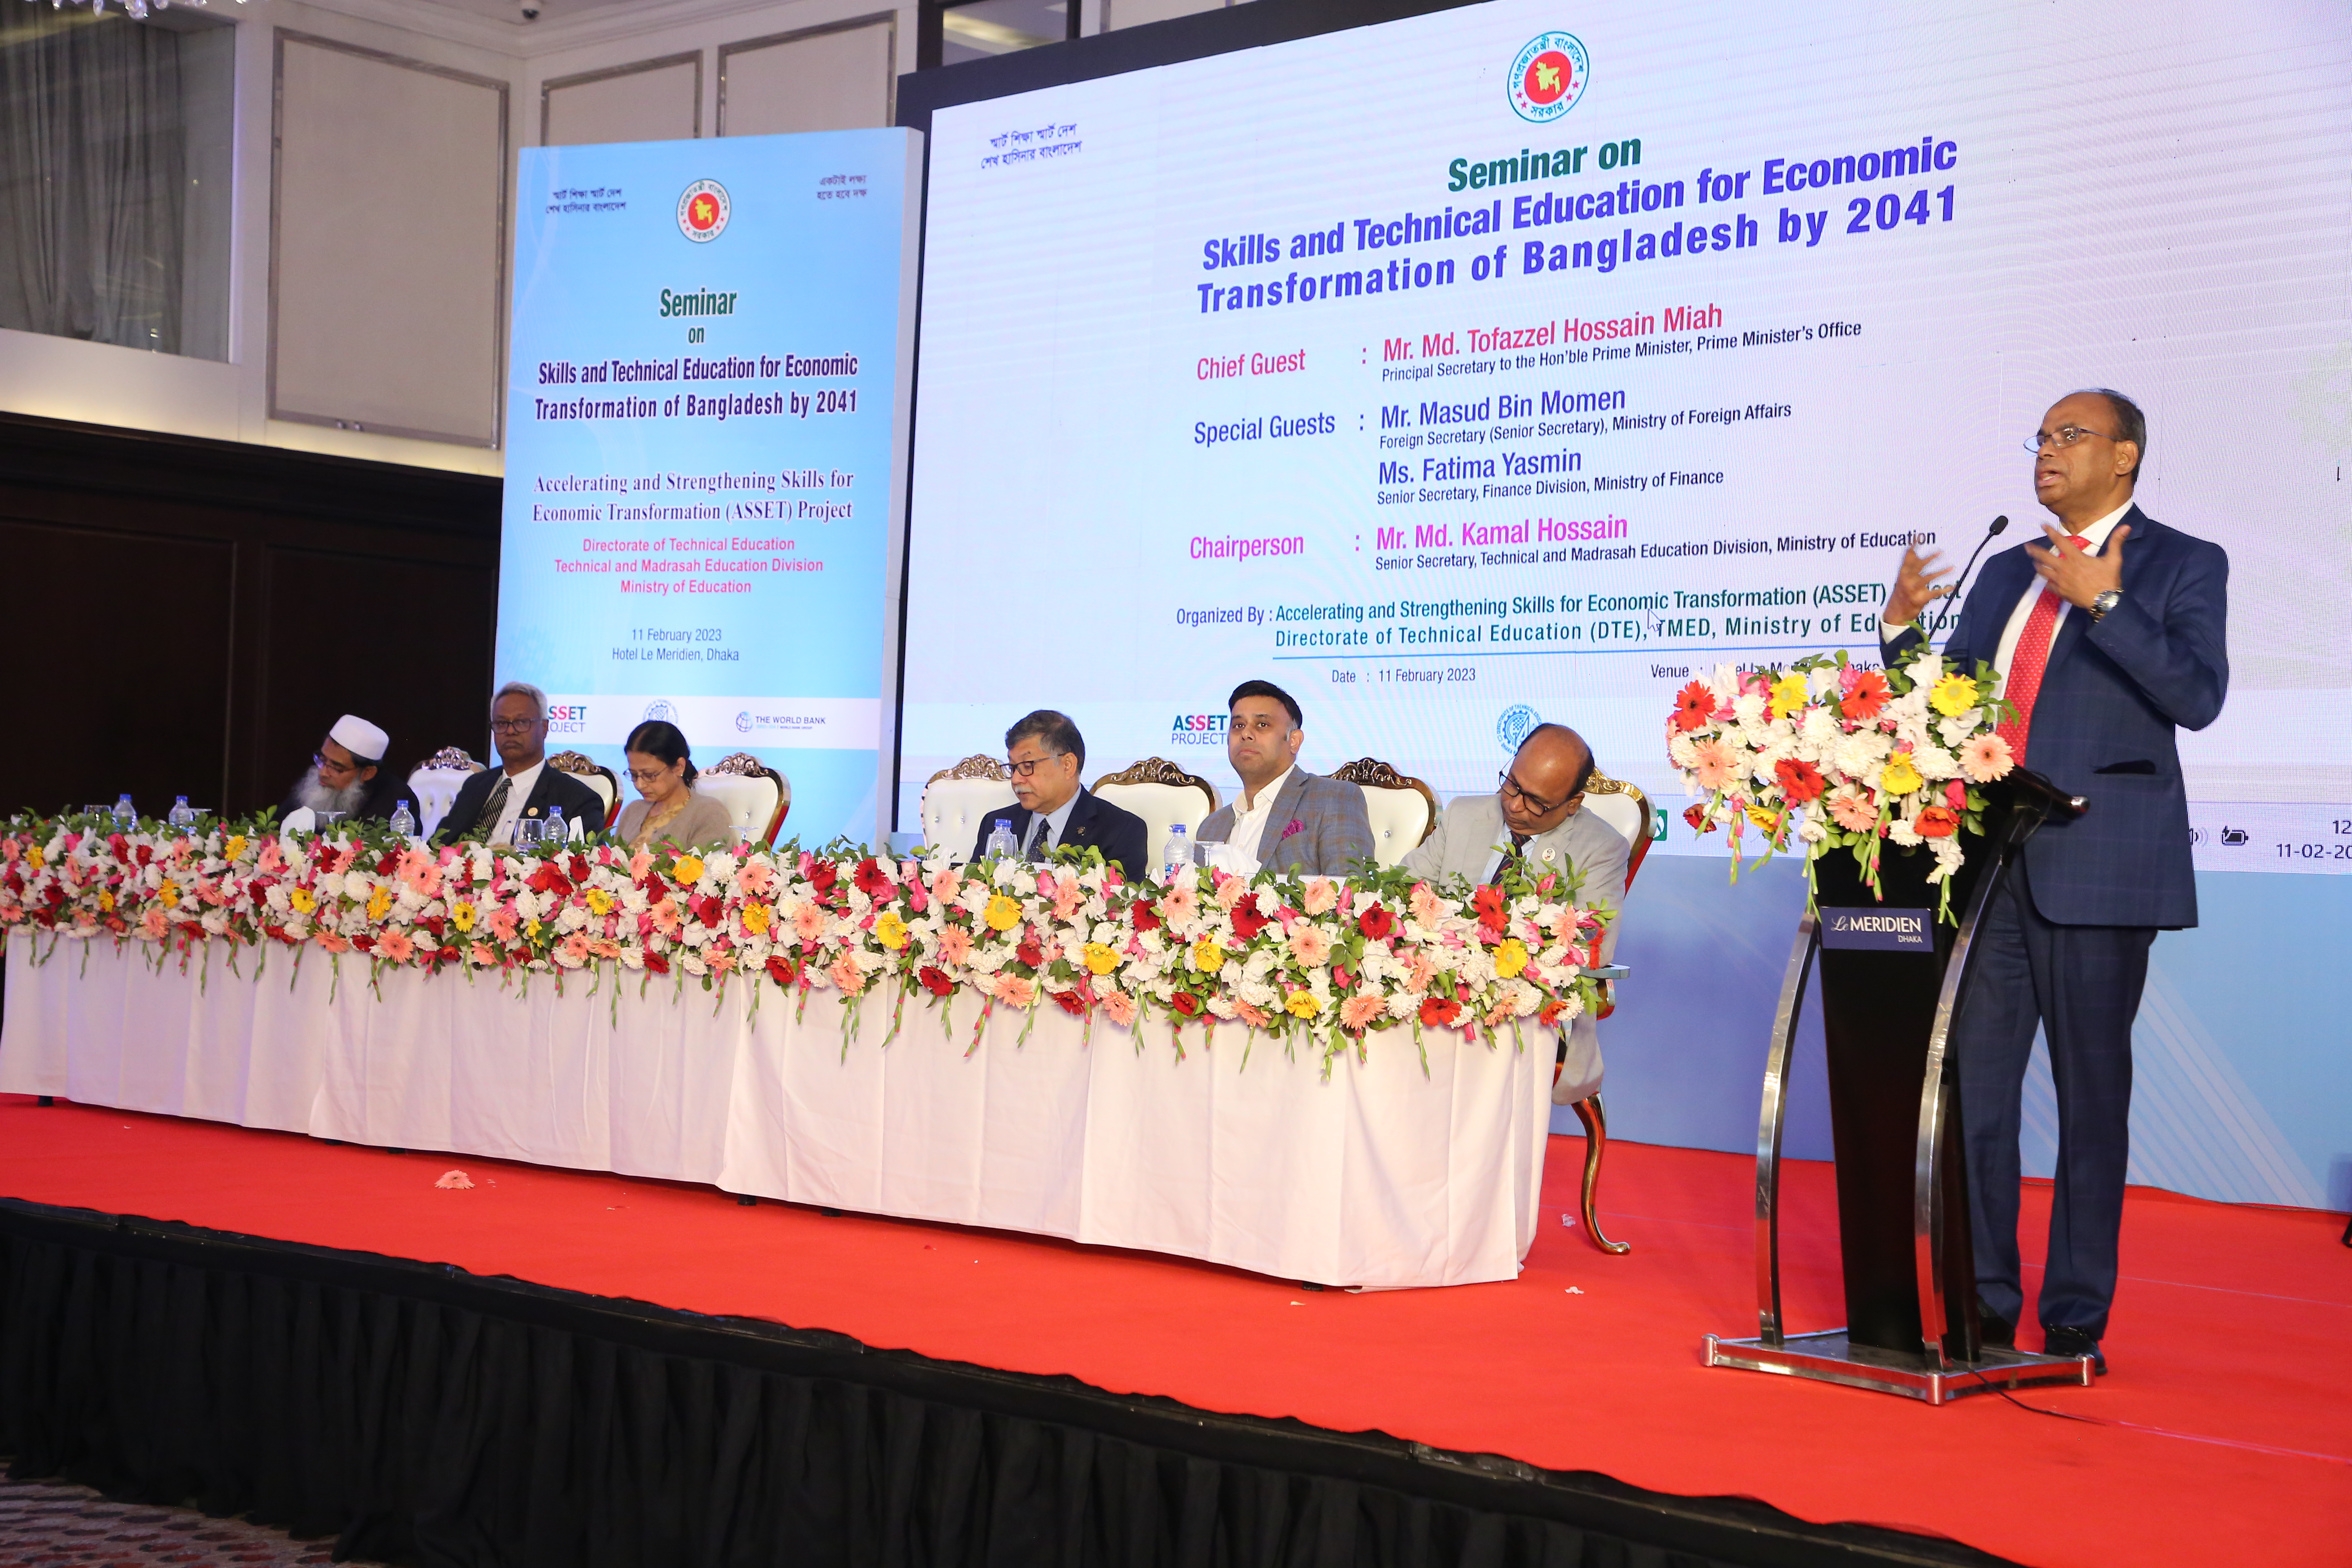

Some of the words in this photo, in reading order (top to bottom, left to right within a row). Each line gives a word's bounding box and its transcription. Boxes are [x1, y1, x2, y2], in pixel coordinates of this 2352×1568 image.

[1448, 146, 1588, 192] Seminar
[1599, 138, 1641, 169] on
[1203, 234, 1280, 270] Skills
[1290, 222, 1344, 259] and
[1354, 200, 1501, 250] Technical
[1513, 180, 1684, 229] Education
[1697, 168, 1751, 203] for
[1763, 136, 1957, 194] Economic
[1198, 257, 1454, 313] Transformation
[1472, 245, 1507, 281] of
[1523, 214, 1757, 274] Bangladesh
[1779, 207, 1828, 247] by
[1847, 185, 1954, 234] 2041
[660, 288, 737, 317] Seminar
[688, 327, 704, 343] on
[1198, 354, 1245, 380] Chief
[1252, 349, 1305, 375] Guest
[1384, 338, 1413, 361] Mr.
[1423, 332, 1459, 358] Md.
[1468, 321, 1555, 353] Tofazzel
[1564, 312, 1654, 344] Hossain
[1664, 303, 1722, 332] Miah
[1383, 364, 1433, 381] Principal
[1437, 361, 1495, 376] Secretary
[1500, 358, 1511, 370] to
[1516, 355, 1535, 369] the
[1593, 346, 1630, 361] Prime
[1635, 340, 1692, 357] Minister,
[1697, 335, 1737, 350] Prime
[1818, 322, 1861, 339] Office
[539, 362, 576, 384] Skills
[581, 361, 607, 383] and
[612, 359, 678, 382] Technical
[684, 357, 754, 379] Education
[760, 355, 780, 377] for
[786, 353, 857, 376] Economic
[536, 396, 656, 419] Transformation
[664, 395, 679, 416] of
[687, 392, 782, 421] Bangladesh
[791, 392, 809, 418] by
[817, 390, 855, 412] 2041
[1195, 418, 1262, 448] Special
[1270, 412, 1335, 438] Guests
[1382, 405, 1410, 428] Mr.
[1420, 397, 1489, 425] Masud
[1499, 394, 1532, 419] Bin
[1541, 390, 1625, 415] Momen
[1380, 434, 1423, 450] Foreign
[1428, 430, 1486, 445] Secretary
[1490, 425, 1534, 443] (Senior
[1538, 418, 1607, 436] Secretary),
[1613, 414, 1666, 430] Ministry
[1671, 411, 1684, 425] of
[1689, 408, 1740, 425] Foreign
[1744, 403, 1791, 419] Affairs
[1380, 461, 1414, 484] Ms.
[1423, 456, 1495, 481] Fatima
[1502, 448, 1581, 476] Yasmin
[533, 474, 628, 494] Accelerating
[634, 474, 660, 490] and
[667, 472, 775, 492] Strengthening
[782, 471, 824, 488] Skills
[831, 470, 853, 487] for
[1378, 490, 1414, 505] Senior
[1419, 487, 1479, 502] Secretary,
[1483, 484, 1531, 498] Finance
[1537, 479, 1589, 494] Division,
[1595, 475, 1648, 491] Ministry
[1652, 472, 1665, 487] of
[1670, 472, 1724, 486] Finance
[534, 504, 601, 521] Economic
[606, 503, 720, 521] Transformation
[726, 501, 792, 520] (ASSET)
[799, 501, 851, 522] Project
[583, 539, 649, 552] Directorate
[654, 538, 666, 551] of
[669, 538, 727, 551] Technical
[732, 537, 795, 550] Education
[1191, 535, 1303, 562] Chairperson
[1377, 527, 1406, 550] Mr.
[1416, 524, 1452, 548] Md.
[1463, 519, 1529, 546] Kamal
[1538, 514, 1627, 541] Hossain
[1376, 556, 1413, 570] Senior
[1417, 554, 1477, 569] Secretary,
[1481, 550, 1538, 565] Technical
[1543, 548, 1566, 562] and
[1572, 545, 1635, 561] Madrasah
[1641, 543, 1708, 558] Education
[1713, 539, 1772, 555] Division,
[1777, 536, 1836, 552] Ministry
[1841, 533, 1855, 548] of
[1860, 529, 1936, 548] Education
[555, 559, 611, 572] Technical
[615, 559, 637, 572] and
[641, 559, 700, 572] Madrasah
[705, 559, 767, 572] Education
[772, 558, 823, 571] Division
[621, 580, 669, 596] Ministry
[673, 580, 686, 592] of
[689, 580, 751, 592] Education
[1177, 607, 1243, 627] Organized
[1248, 607, 1264, 626] By
[1276, 603, 1363, 623] Accelerating
[1369, 602, 1394, 618] and
[1401, 598, 1506, 620] Strengthening
[1513, 596, 1554, 613] Skills
[1561, 595, 1582, 612] for
[1588, 592, 1668, 611] Economic
[1674, 587, 1806, 608] Transformation
[1813, 584, 1886, 608] (ASSET)
[633, 629, 642, 640] 11
[648, 628, 692, 643] February
[695, 629, 722, 641] 2023
[1276, 629, 1368, 646] Directorate
[1376, 628, 1392, 644] of
[1399, 625, 1481, 643] Technical
[1491, 623, 1581, 641] Education
[1591, 621, 1647, 642] (DTE),
[1659, 618, 1716, 639] TMED,
[1726, 616, 1811, 637] Ministry
[1821, 614, 1841, 633] of
[612, 648, 637, 660] Hotel
[641, 648, 653, 660] Le
[657, 648, 703, 661] Meridien,
[707, 648, 739, 661] Dhaka
[1332, 670, 1356, 682] Date
[1380, 670, 1390, 682] 11
[1396, 669, 1443, 684] February
[1448, 668, 1475, 681] 2023
[1651, 664, 1689, 677] Venue
[548, 706, 586, 720] SSET
[1173, 715, 1227, 731] ASSET
[1172, 733, 1227, 744] PROJECT
[1831, 915, 1849, 931] Le
[1850, 917, 1922, 933] MERIDIEN
[1898, 935, 1922, 943] DHAKA
